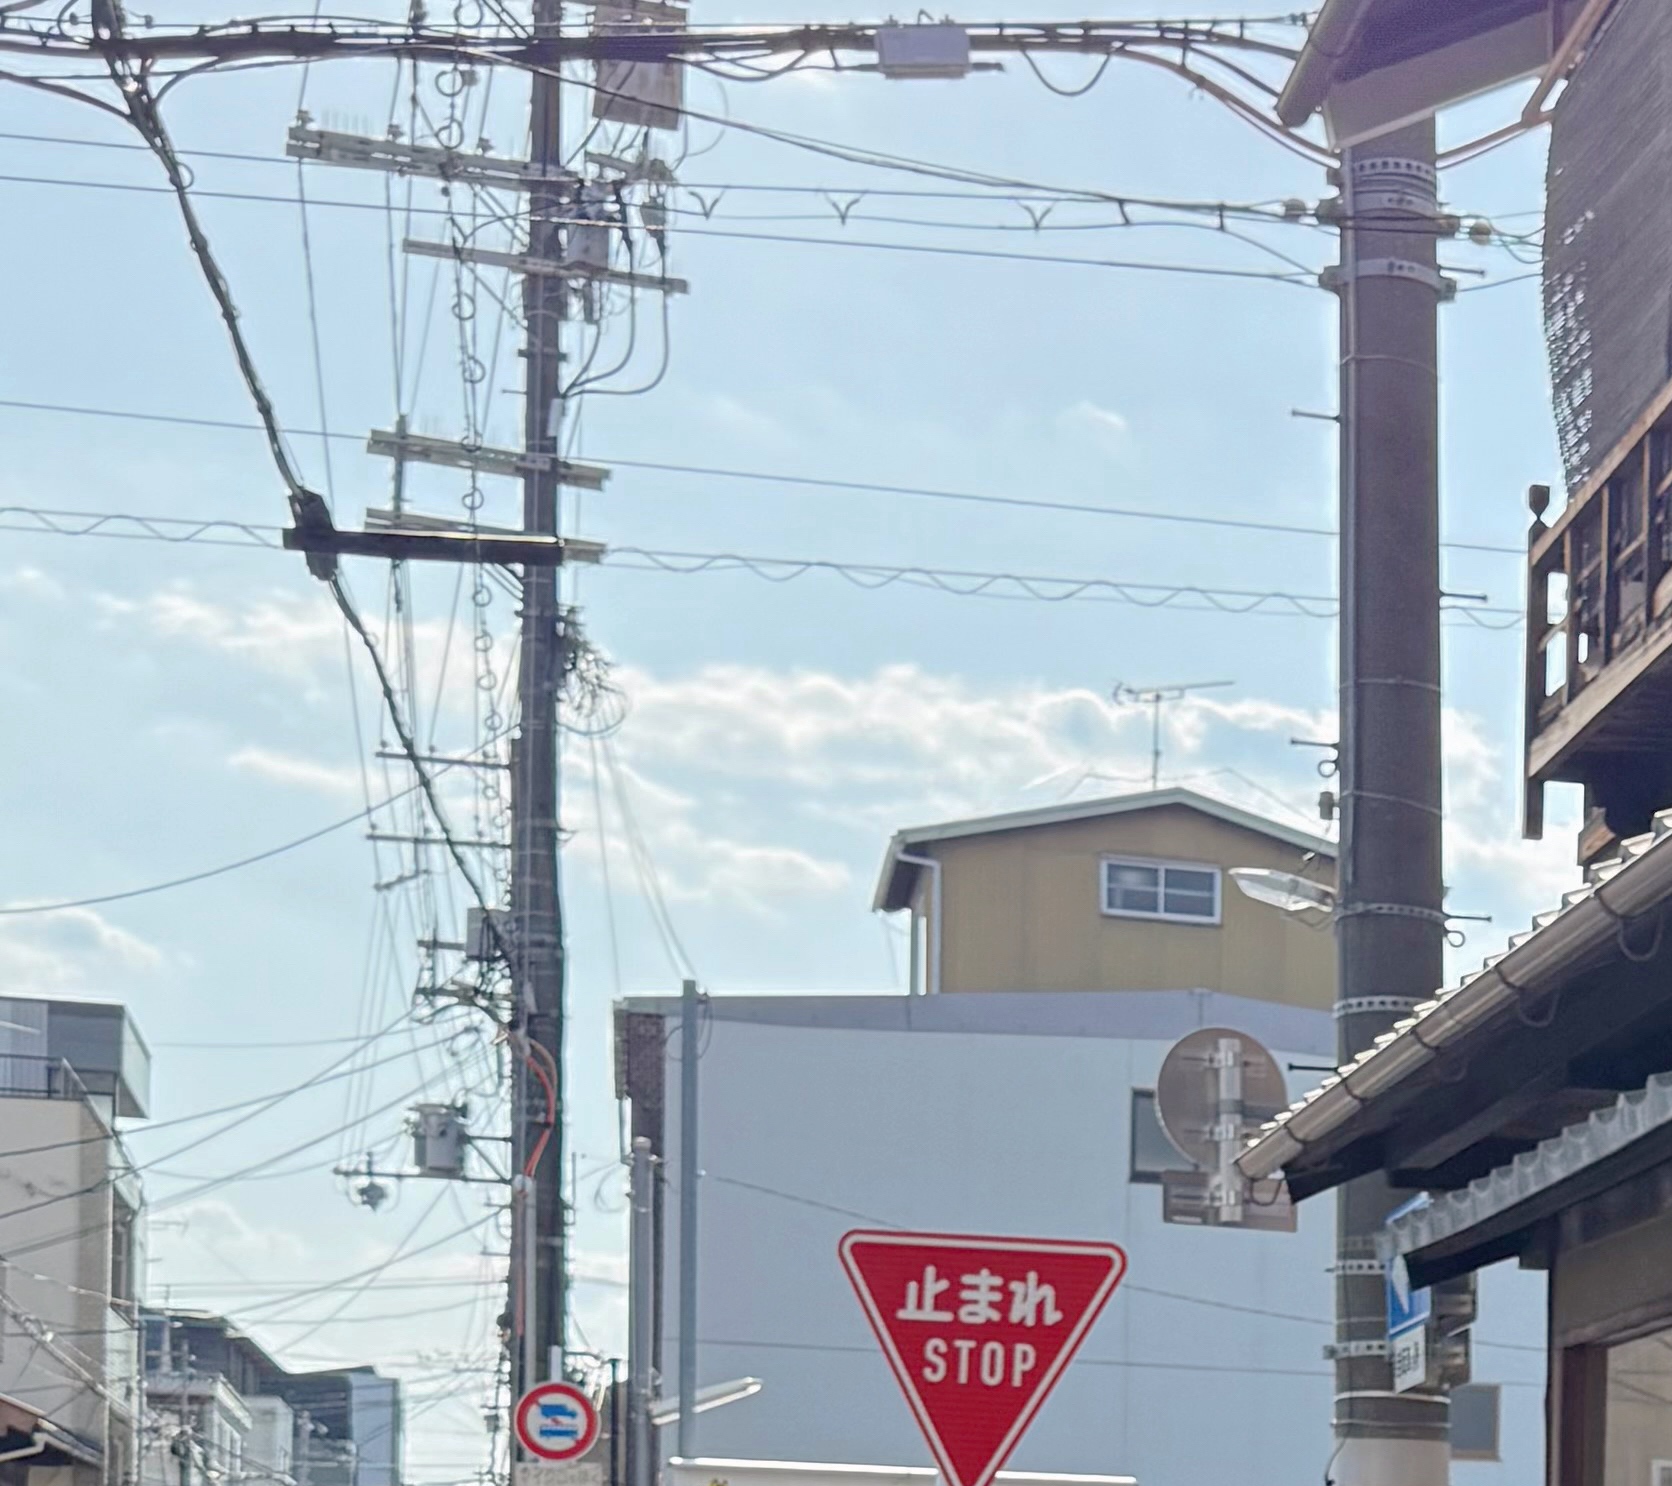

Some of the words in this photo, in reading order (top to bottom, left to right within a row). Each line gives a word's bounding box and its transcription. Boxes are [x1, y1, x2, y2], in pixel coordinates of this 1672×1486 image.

[896, 1265, 1063, 1327] 止まれ
[923, 1338, 1036, 1387] STOP
